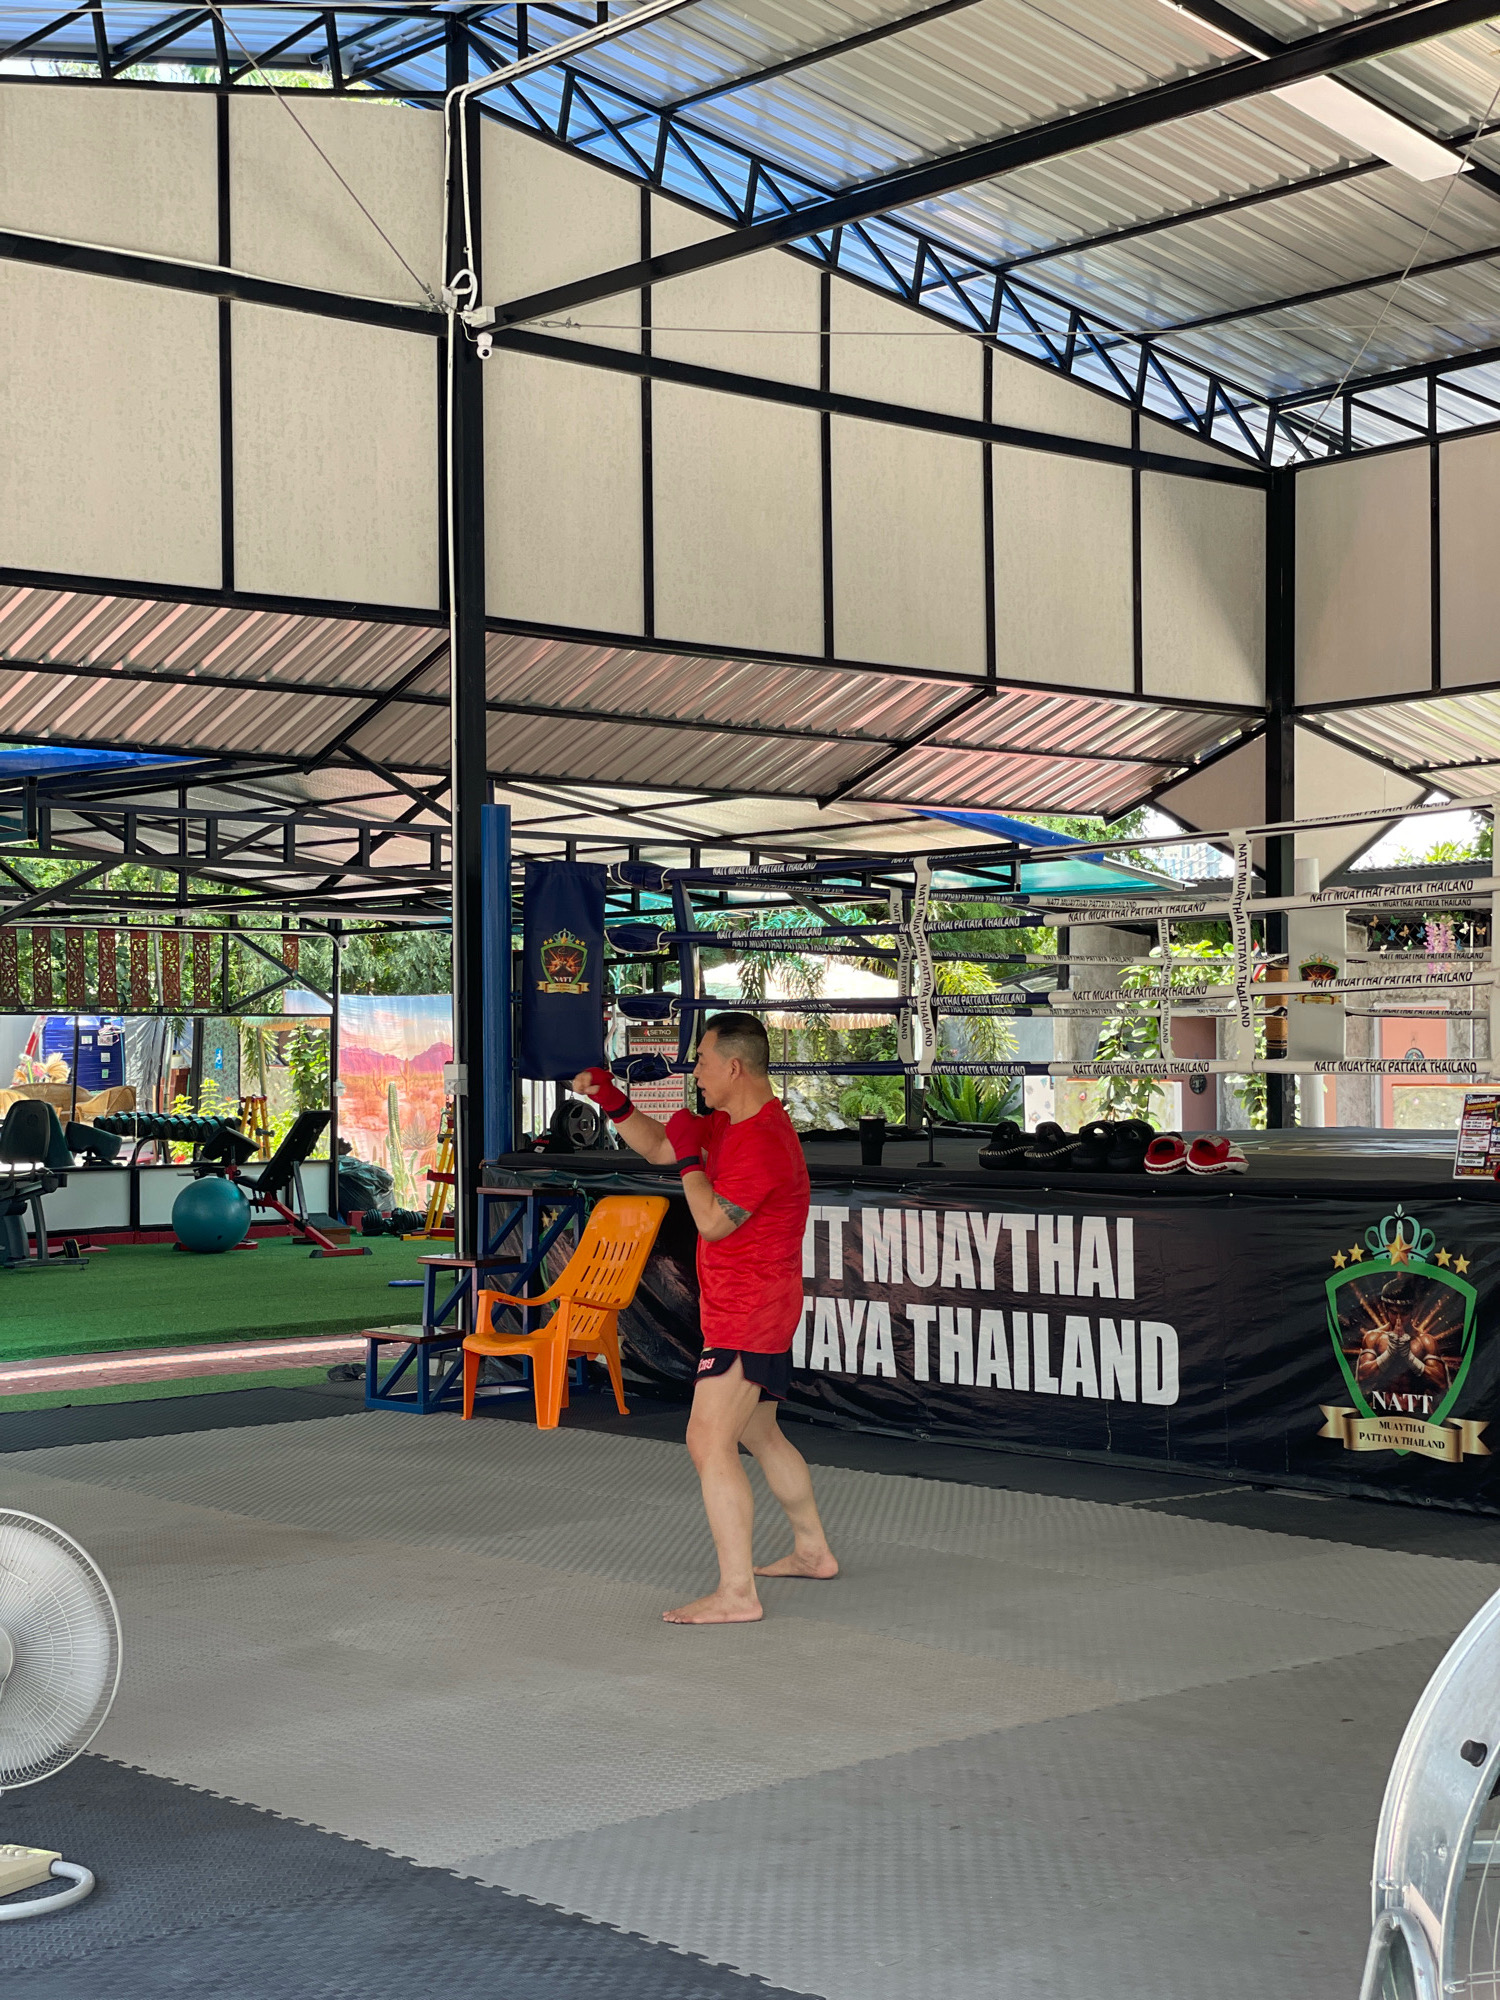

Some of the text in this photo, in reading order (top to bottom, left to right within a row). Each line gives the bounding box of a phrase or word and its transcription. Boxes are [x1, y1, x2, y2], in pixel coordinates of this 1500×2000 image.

[1309, 880, 1474, 903] NATT MUAYTHAI PATTAYA THAILAND
[1382, 900, 1414, 908] MUAYTHAI
[1414, 899, 1440, 907] PATTAYA
[1441, 899, 1472, 907] THAILAND
[1068, 902, 1207, 923] NATT MUAYTHAI PATTAYA THAILAND
[923, 920, 953, 932] UAYTHAI
[954, 919, 983, 929] PATTAYA
[984, 917, 1020, 928] THAILAND
[1232, 843, 1250, 1028] NATT MUAYTHAI PATTAYA THAILAND
[893, 902, 901, 922] NATT
[901, 1008, 909, 1040] AILAND
[912, 883, 932, 1047] NATT MUAYTHAI PATTAYA THAILAND
[1311, 971, 1473, 988] NATT MUAYTHAI PATTAYA THAILAND
[931, 996, 960, 1006] UAYTHAI
[961, 995, 990, 1005] PATTAYA
[991, 993, 1026, 1004] THAILAND
[1072, 986, 1208, 1001] NATT MUAYTHAI PATTAYA THAILAND
[931, 1066, 958, 1075] AYTHAI
[959, 1066, 988, 1075] PATTAYA
[989, 1066, 1026, 1076] THAILAND
[1073, 1062, 1210, 1075] NATT MUAYTHAI PATTAYA THAILAND
[1314, 1061, 1477, 1073] NATT MUAYTHAI PATTAYA THAILAND
[801, 1205, 1135, 1300] TT MUAYTHAI
[792, 1296, 1180, 1406] TAYA THAILAND
[1372, 1390, 1434, 1415] NATT
[1379, 1421, 1425, 1434] MUAYTHAI
[1359, 1432, 1445, 1450] PATTAYA THAILAND
